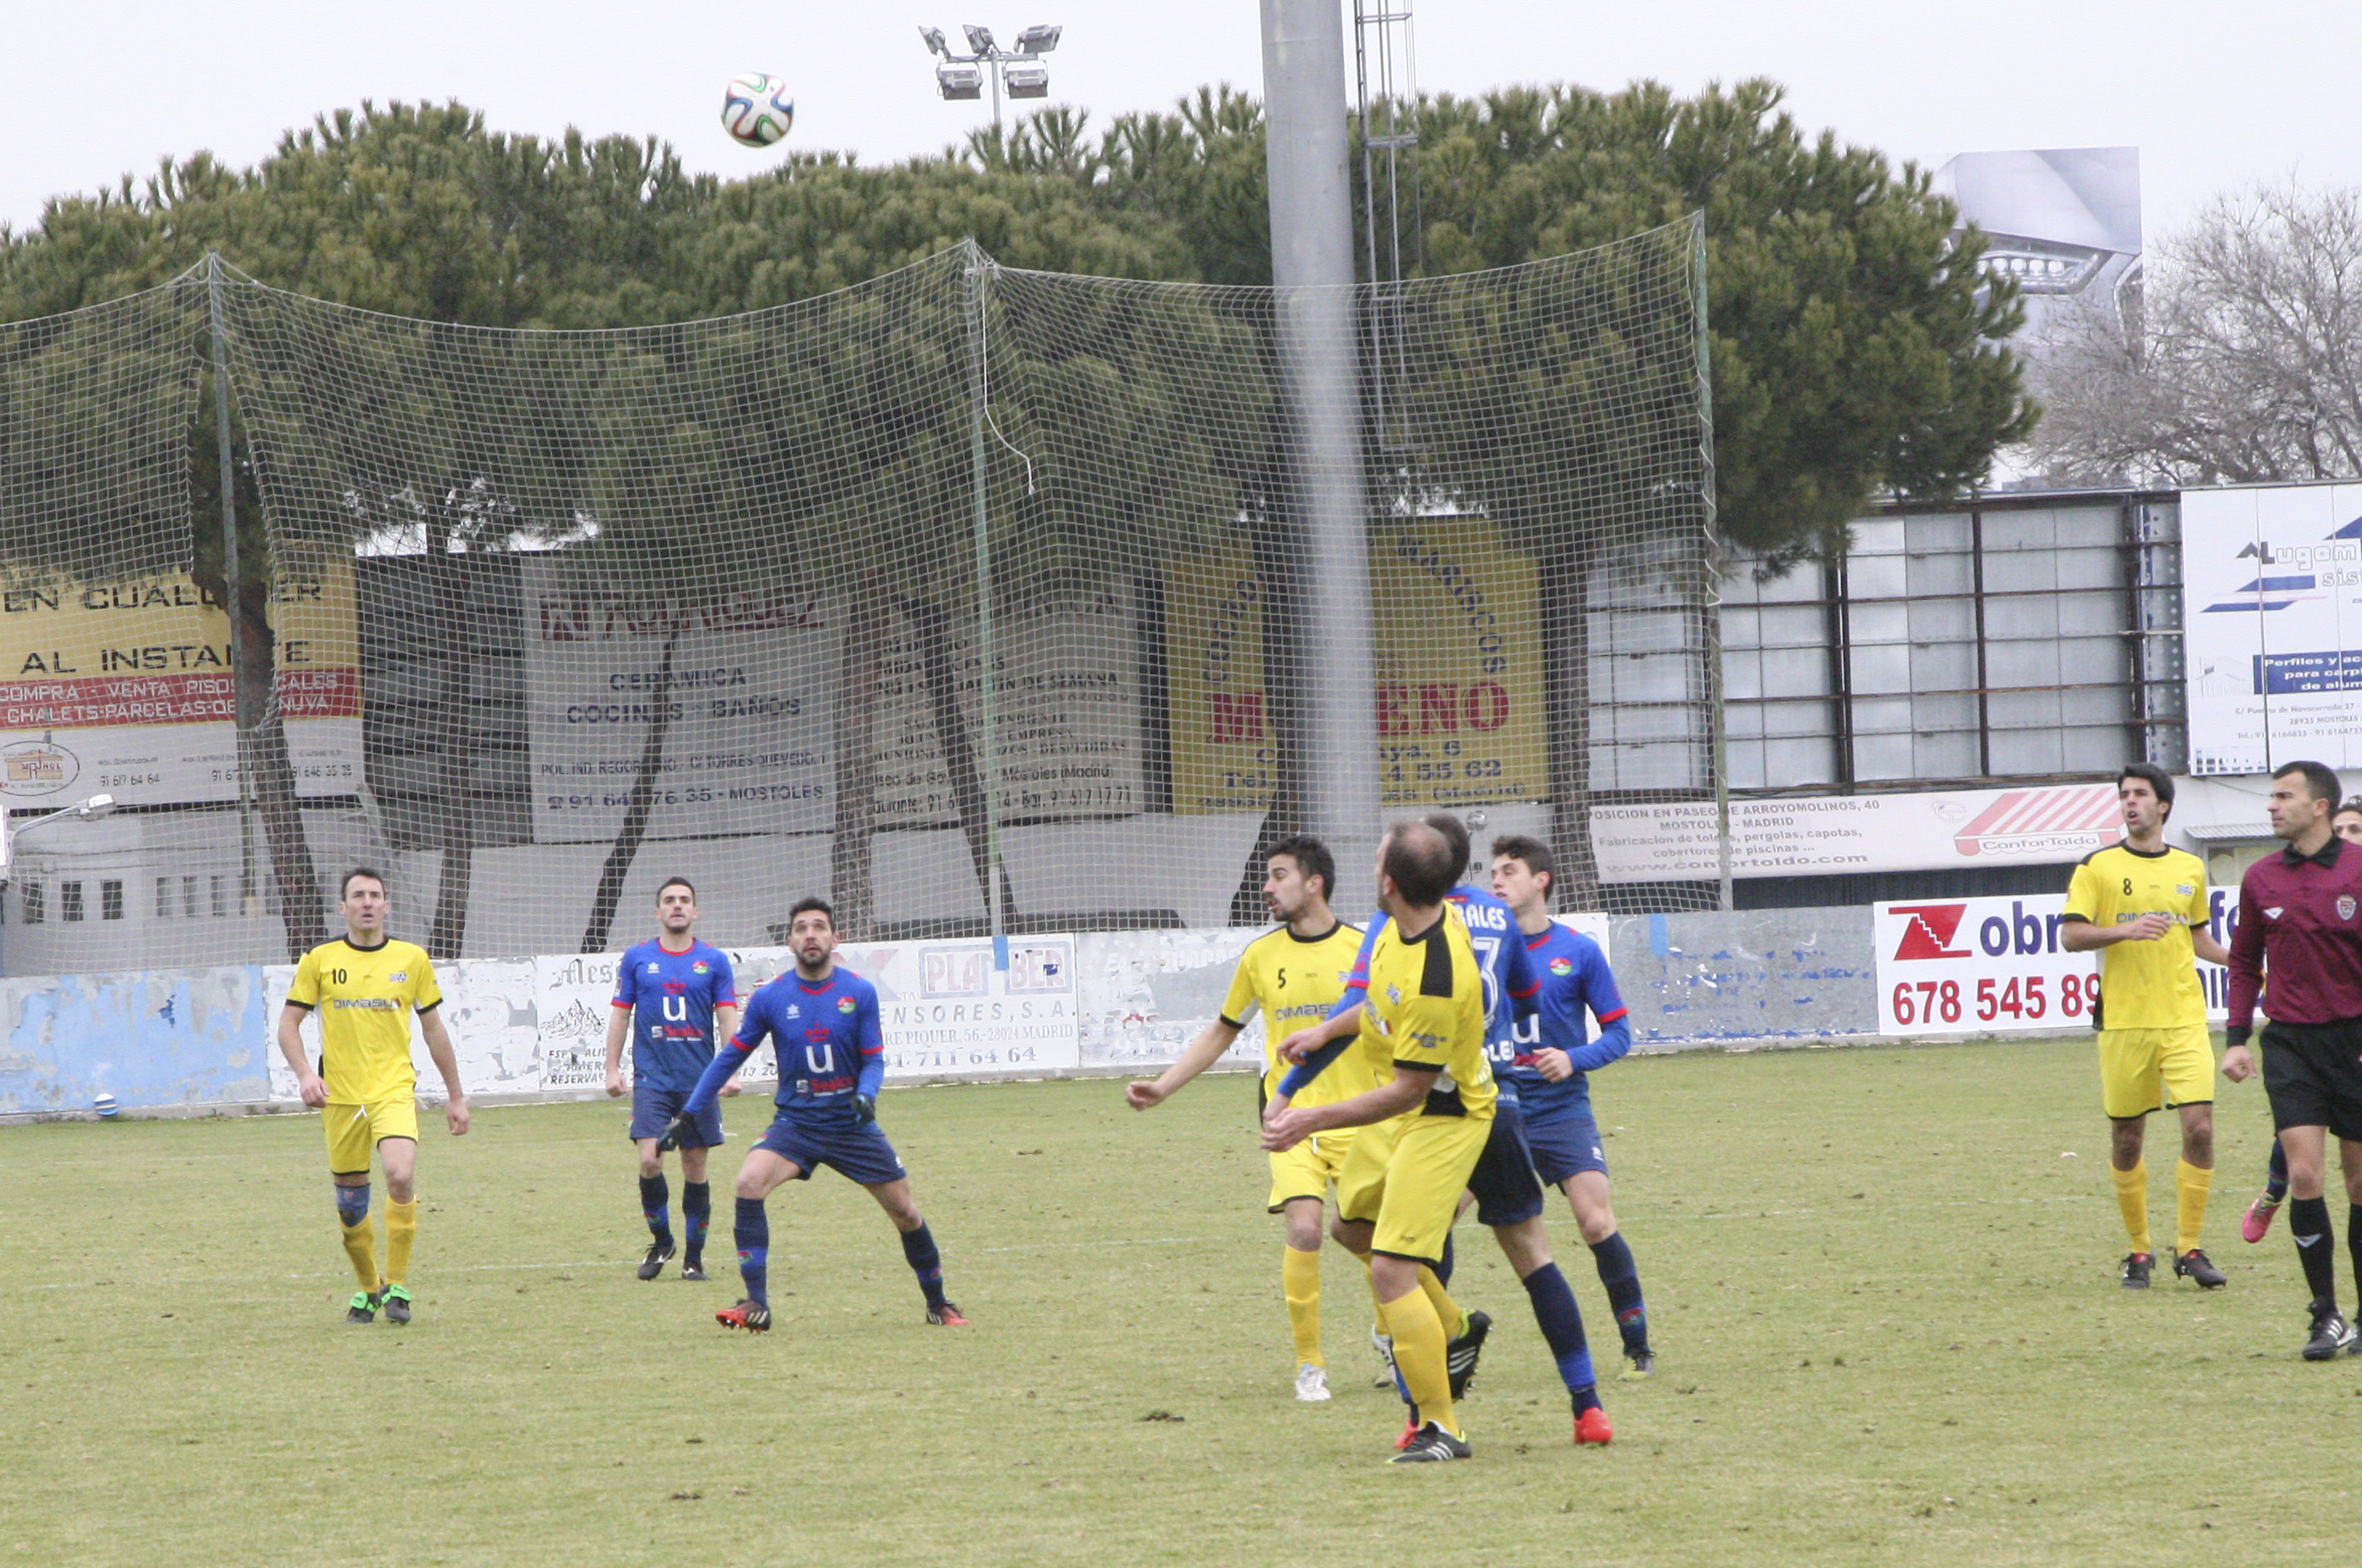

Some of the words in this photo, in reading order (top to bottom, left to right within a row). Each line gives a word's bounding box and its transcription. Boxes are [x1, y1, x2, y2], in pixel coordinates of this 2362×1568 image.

[4, 589, 59, 612] EN
[20, 652, 76, 674] AL
[2264, 658, 2324, 668] Perfiles
[2328, 657, 2337, 665] y
[2285, 669, 2320, 680] para
[0, 684, 80, 703] COMPRA
[107, 681, 170, 698] VENTA
[2302, 682, 2321, 691] de
[567, 702, 683, 723] COCINS
[1465, 759, 1503, 778] 62
[148, 773, 160, 785] 64
[729, 784, 823, 801] MOSTOLES
[1654, 808, 1671, 818] EN
[1675, 807, 1717, 817] PASEO
[1744, 801, 1861, 815] ARROYOMOLINOS,
[1864, 800, 1880, 809] 40
[1743, 817, 1794, 828] MADRID
[1806, 827, 1862, 839] capotas,
[1746, 843, 1799, 856] piscinas
[1982, 837, 2097, 850] ConforToldo
[2123, 877, 2133, 896] 8
[332, 968, 348, 985] 10
[1278, 967, 1286, 989] 5
[1893, 979, 1962, 1026] 678
[1977, 976, 2046, 1022] 545
[1022, 1023, 1073, 1039] MADRID
[969, 1046, 999, 1065] 64
[1007, 1045, 1037, 1063] 64
